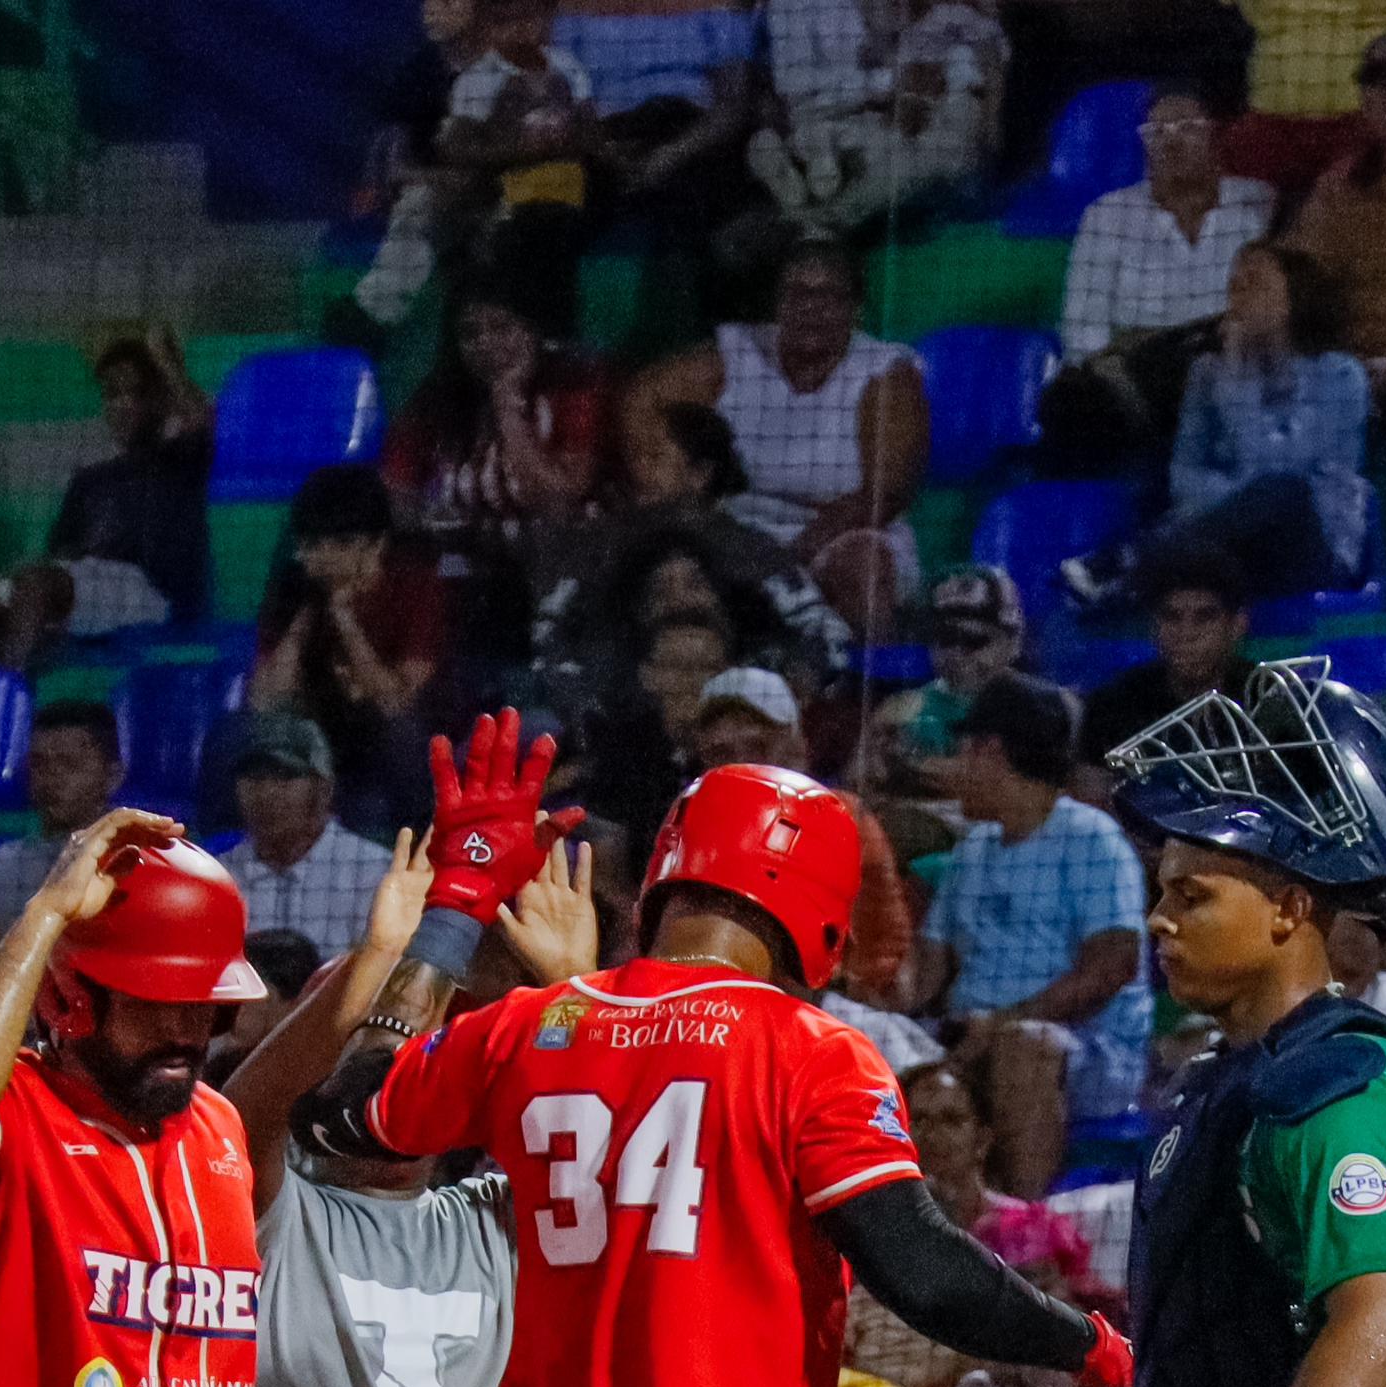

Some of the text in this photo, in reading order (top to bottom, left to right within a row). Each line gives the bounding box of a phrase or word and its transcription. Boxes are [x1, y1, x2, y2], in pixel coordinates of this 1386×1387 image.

[610, 1016, 730, 1049] BOLÍVAR
[519, 1079, 708, 1267] 34
[82, 1248, 262, 1333] TIGRE
